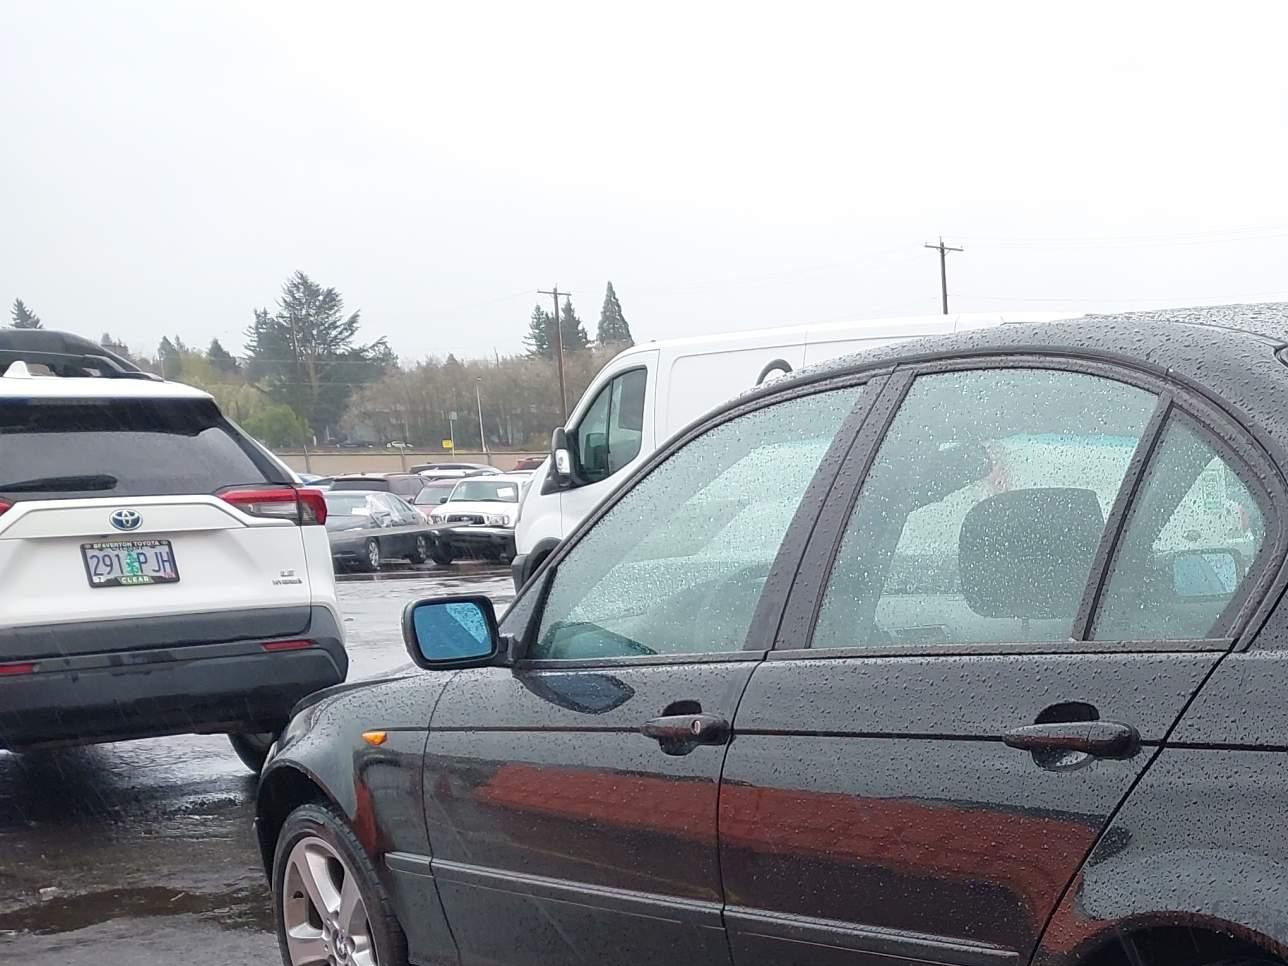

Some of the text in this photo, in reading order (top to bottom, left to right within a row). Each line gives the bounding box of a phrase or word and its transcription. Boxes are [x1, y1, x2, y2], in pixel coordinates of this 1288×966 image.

[93, 541, 132, 549] BEAVERTON
[89, 553, 124, 577] 291
[121, 575, 149, 583] CLEAR
